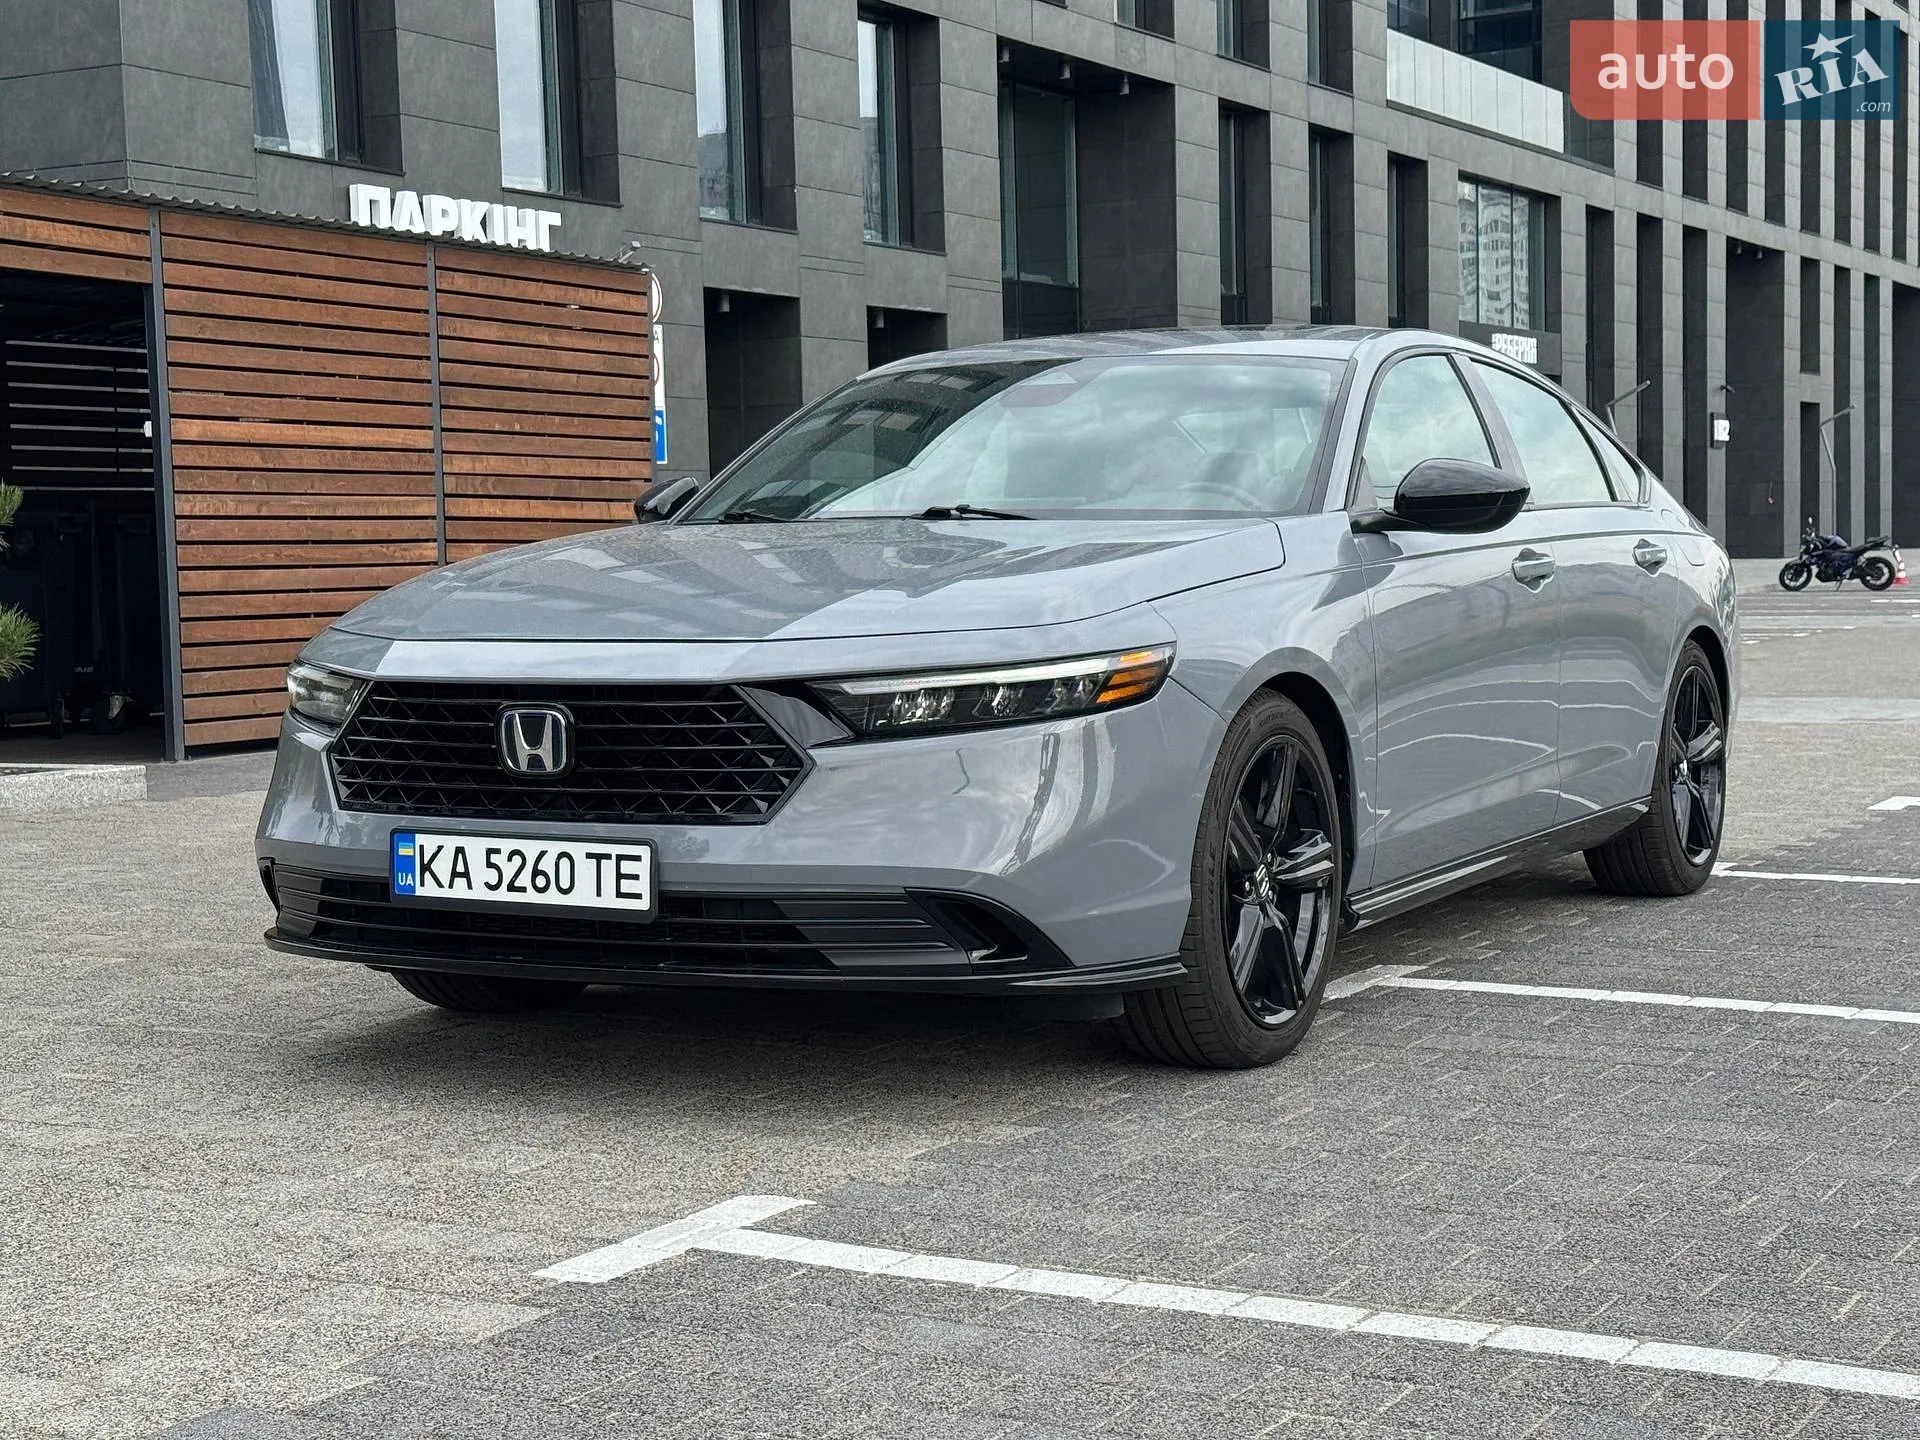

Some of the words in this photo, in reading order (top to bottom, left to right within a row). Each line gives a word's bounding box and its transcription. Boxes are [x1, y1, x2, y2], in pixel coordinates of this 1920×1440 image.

[349, 183, 561, 252] ПАРКІНГ
[398, 872, 414, 886] UA
[418, 844, 473, 890] KA
[483, 847, 575, 895] 5260
[585, 852, 643, 900] TE
